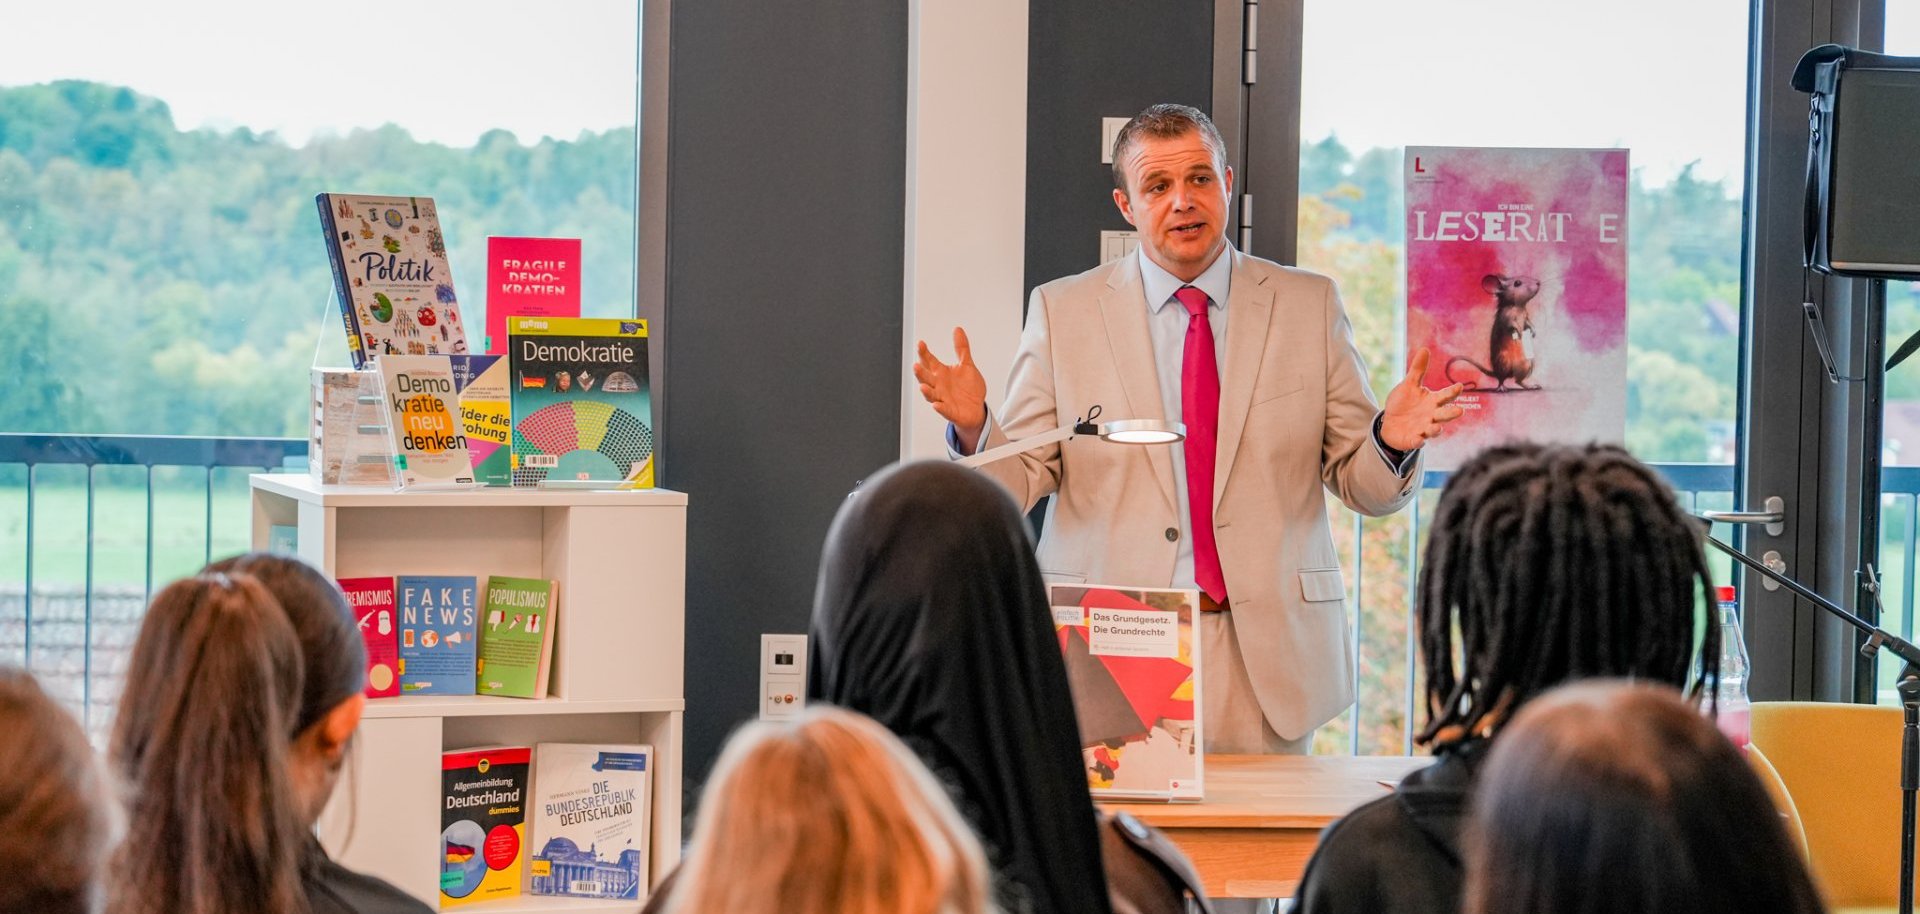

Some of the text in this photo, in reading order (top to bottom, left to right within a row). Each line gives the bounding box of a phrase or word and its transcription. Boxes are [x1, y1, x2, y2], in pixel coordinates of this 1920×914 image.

[1415, 157, 1425, 172] L
[359, 252, 434, 281] Politik
[503, 259, 566, 271] FRAGILE
[509, 271, 560, 283] DEMO-
[502, 284, 565, 295] KRATIEN
[523, 341, 634, 363] Demokratie
[397, 374, 451, 393] Demo
[392, 393, 445, 413] kratie
[410, 415, 444, 430] neu
[459, 407, 510, 426] ider die
[403, 431, 468, 450] denken
[404, 588, 472, 606] FAKE
[489, 588, 547, 608] POPULISMUS
[403, 606, 473, 626] NEWS
[1093, 613, 1171, 624] Das Grundgesetz.
[1093, 626, 1165, 636] Die Grundrechte
[454, 778, 513, 792] Allgemeinbildung
[592, 780, 610, 795] DIE
[446, 788, 520, 809] Deutschland
[545, 788, 636, 816] BUNDESREPUBLIK
[488, 806, 520, 815] dummies
[560, 801, 633, 827] DEUTSCHLAND
